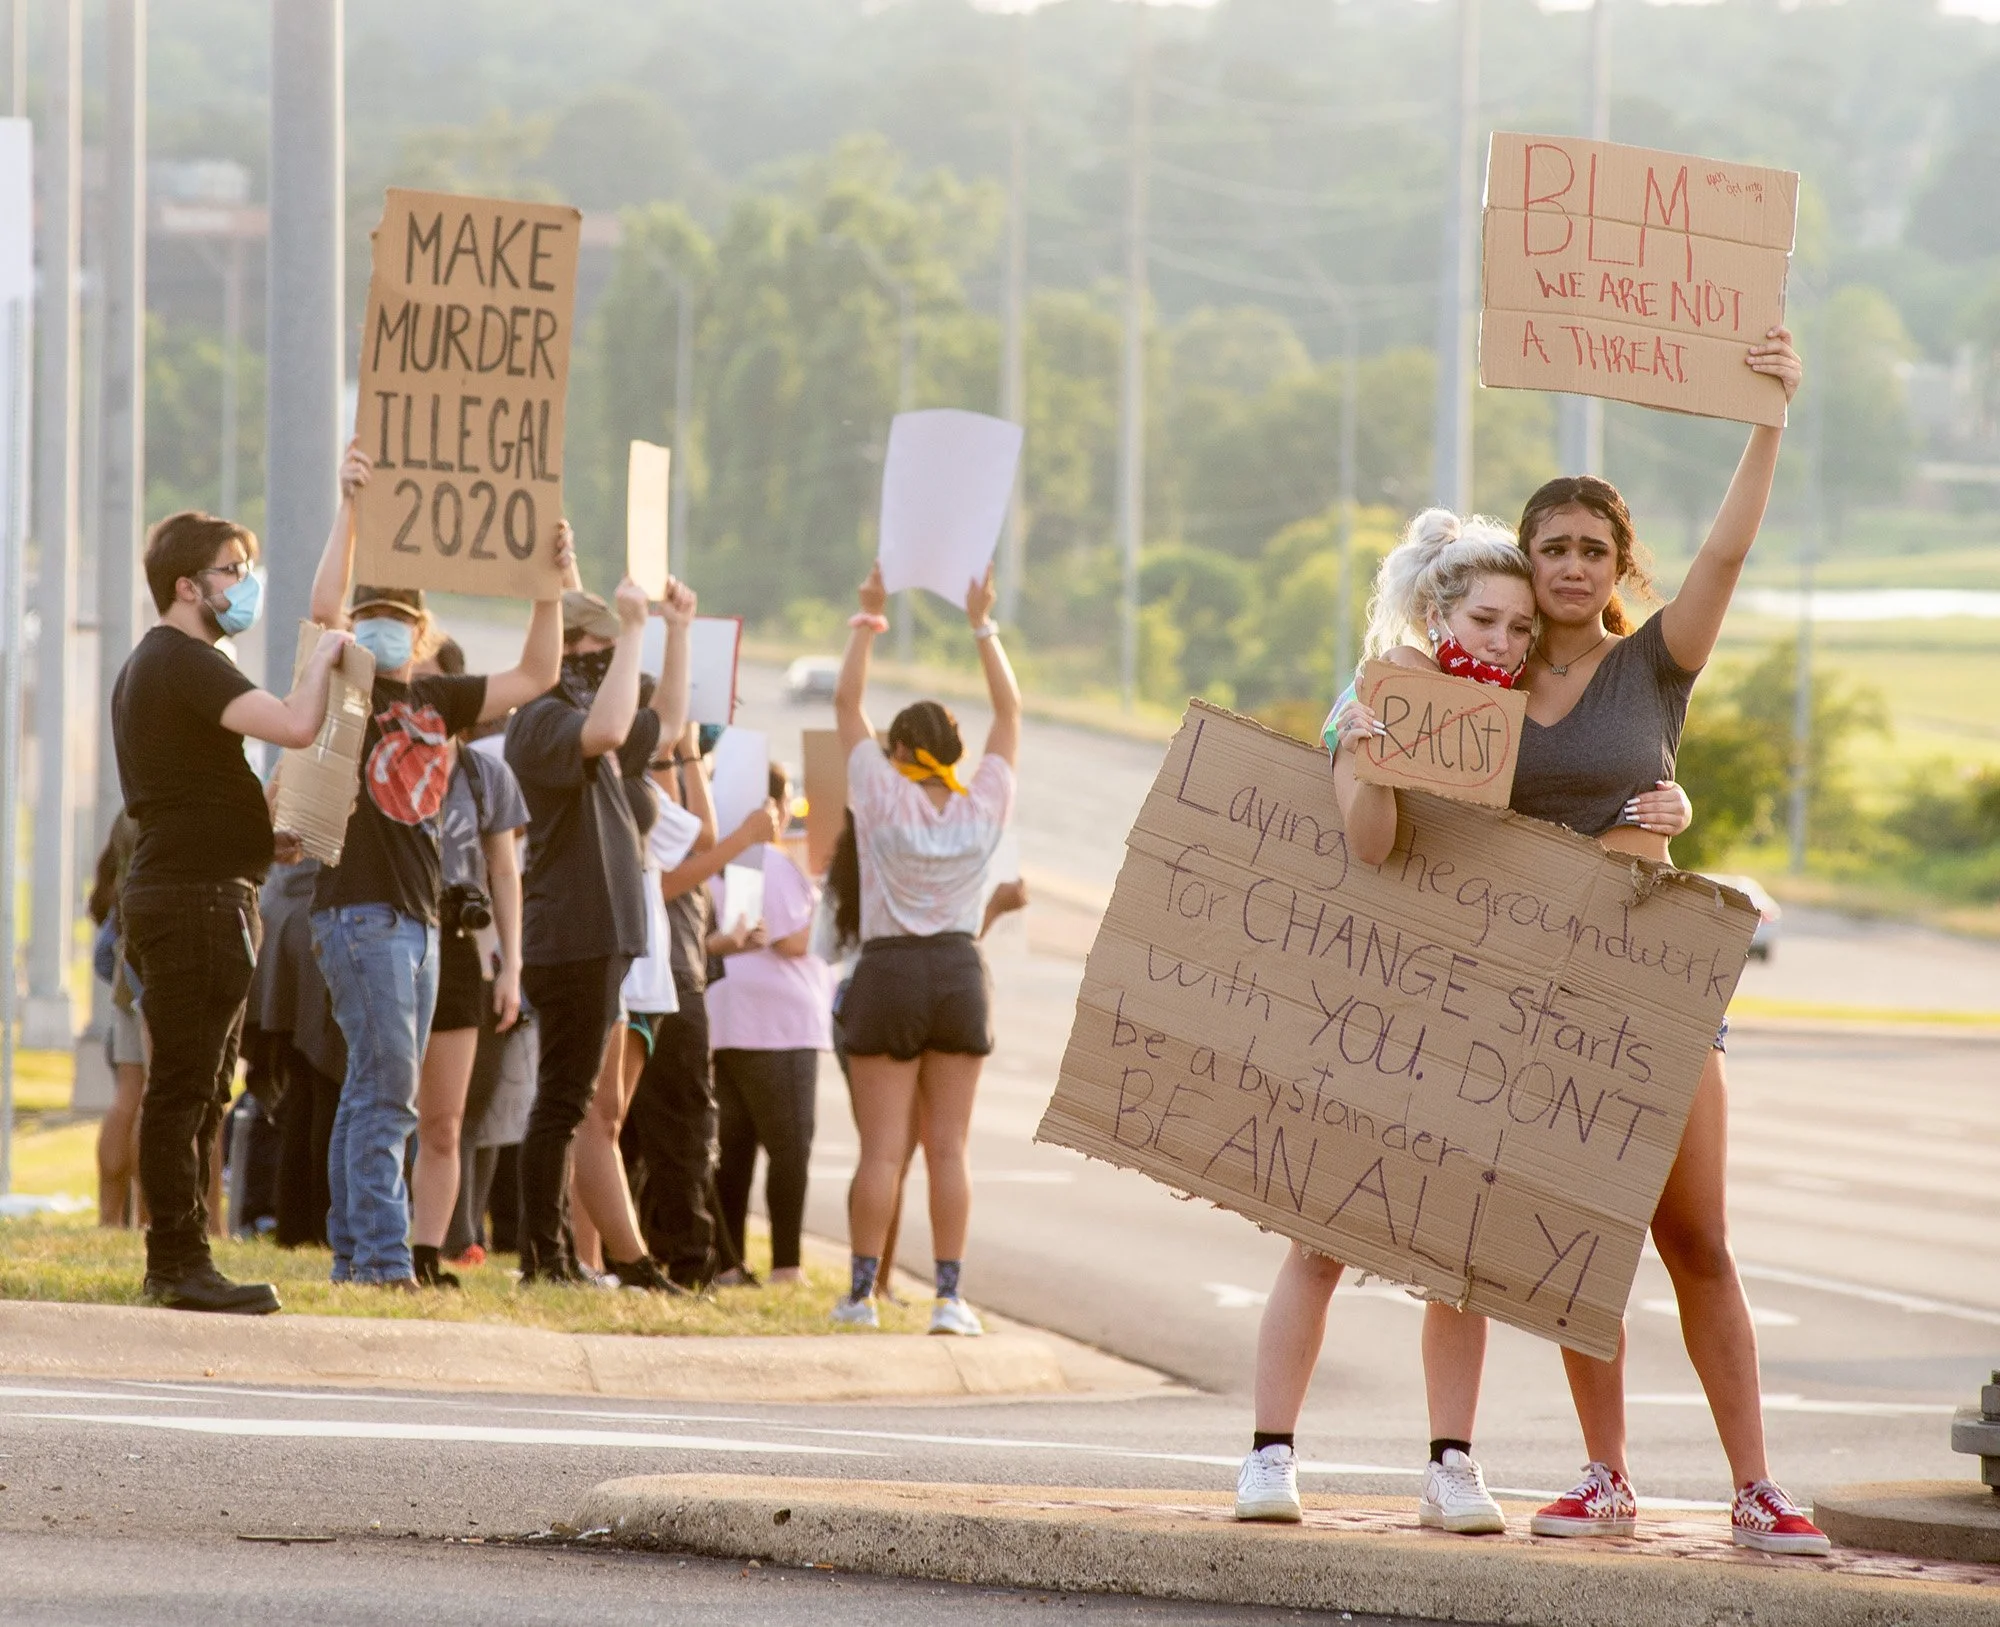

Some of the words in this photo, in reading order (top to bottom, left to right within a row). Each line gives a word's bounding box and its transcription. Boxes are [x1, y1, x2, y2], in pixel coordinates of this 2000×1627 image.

[405, 211, 563, 292] MAKE
[1523, 143, 1692, 282] BLM
[372, 300, 557, 380] MURDER
[1521, 319, 1550, 363] A
[1535, 268, 1585, 298] WE
[1599, 272, 1657, 316] ARE
[1671, 279, 1743, 331] NOT
[374, 391, 559, 482] ILLEGAL
[392, 478, 536, 560] 2020
[1177, 719, 1349, 891] Laying
[1378, 825, 1455, 893] he
[1456, 877, 1732, 1003] groundwork
[1164, 844, 1228, 922] for
[1243, 877, 1479, 1021] CHANGE
[1112, 991, 1167, 1060] be
[1190, 1045, 1216, 1082] a
[1149, 944, 1270, 1021] with
[1309, 979, 1425, 1081] YOU.
[1457, 1040, 1666, 1162] DON'T
[1114, 1066, 1214, 1161] BE
[1202, 1113, 1319, 1214] AN
